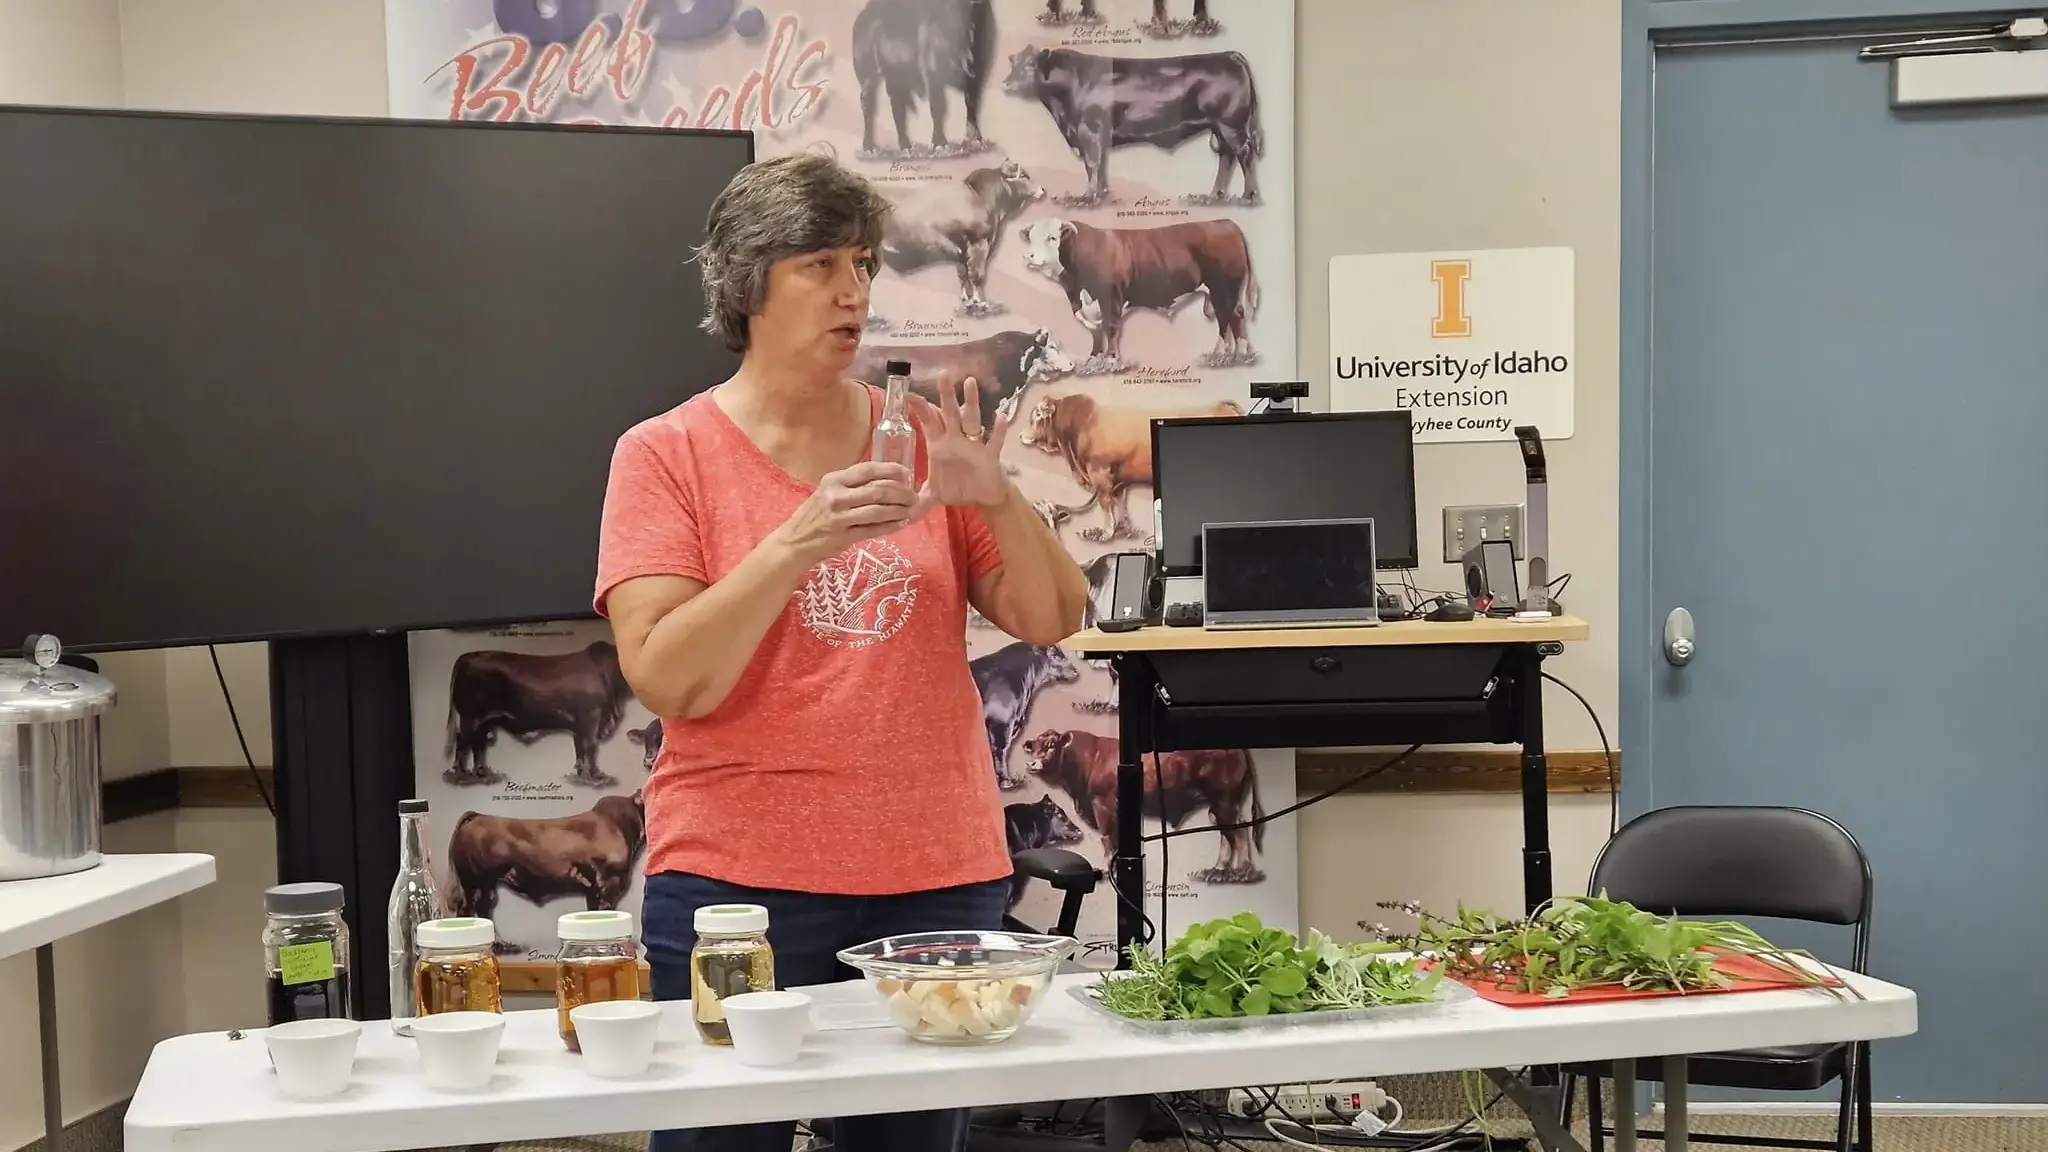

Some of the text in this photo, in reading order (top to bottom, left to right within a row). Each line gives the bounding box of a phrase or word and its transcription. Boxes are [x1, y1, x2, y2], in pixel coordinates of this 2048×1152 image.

[1337, 350, 1568, 384] University of Idaho
[1396, 386, 1508, 408] Extension
[1457, 416, 1512, 433] County
[848, 638, 874, 649] THE
